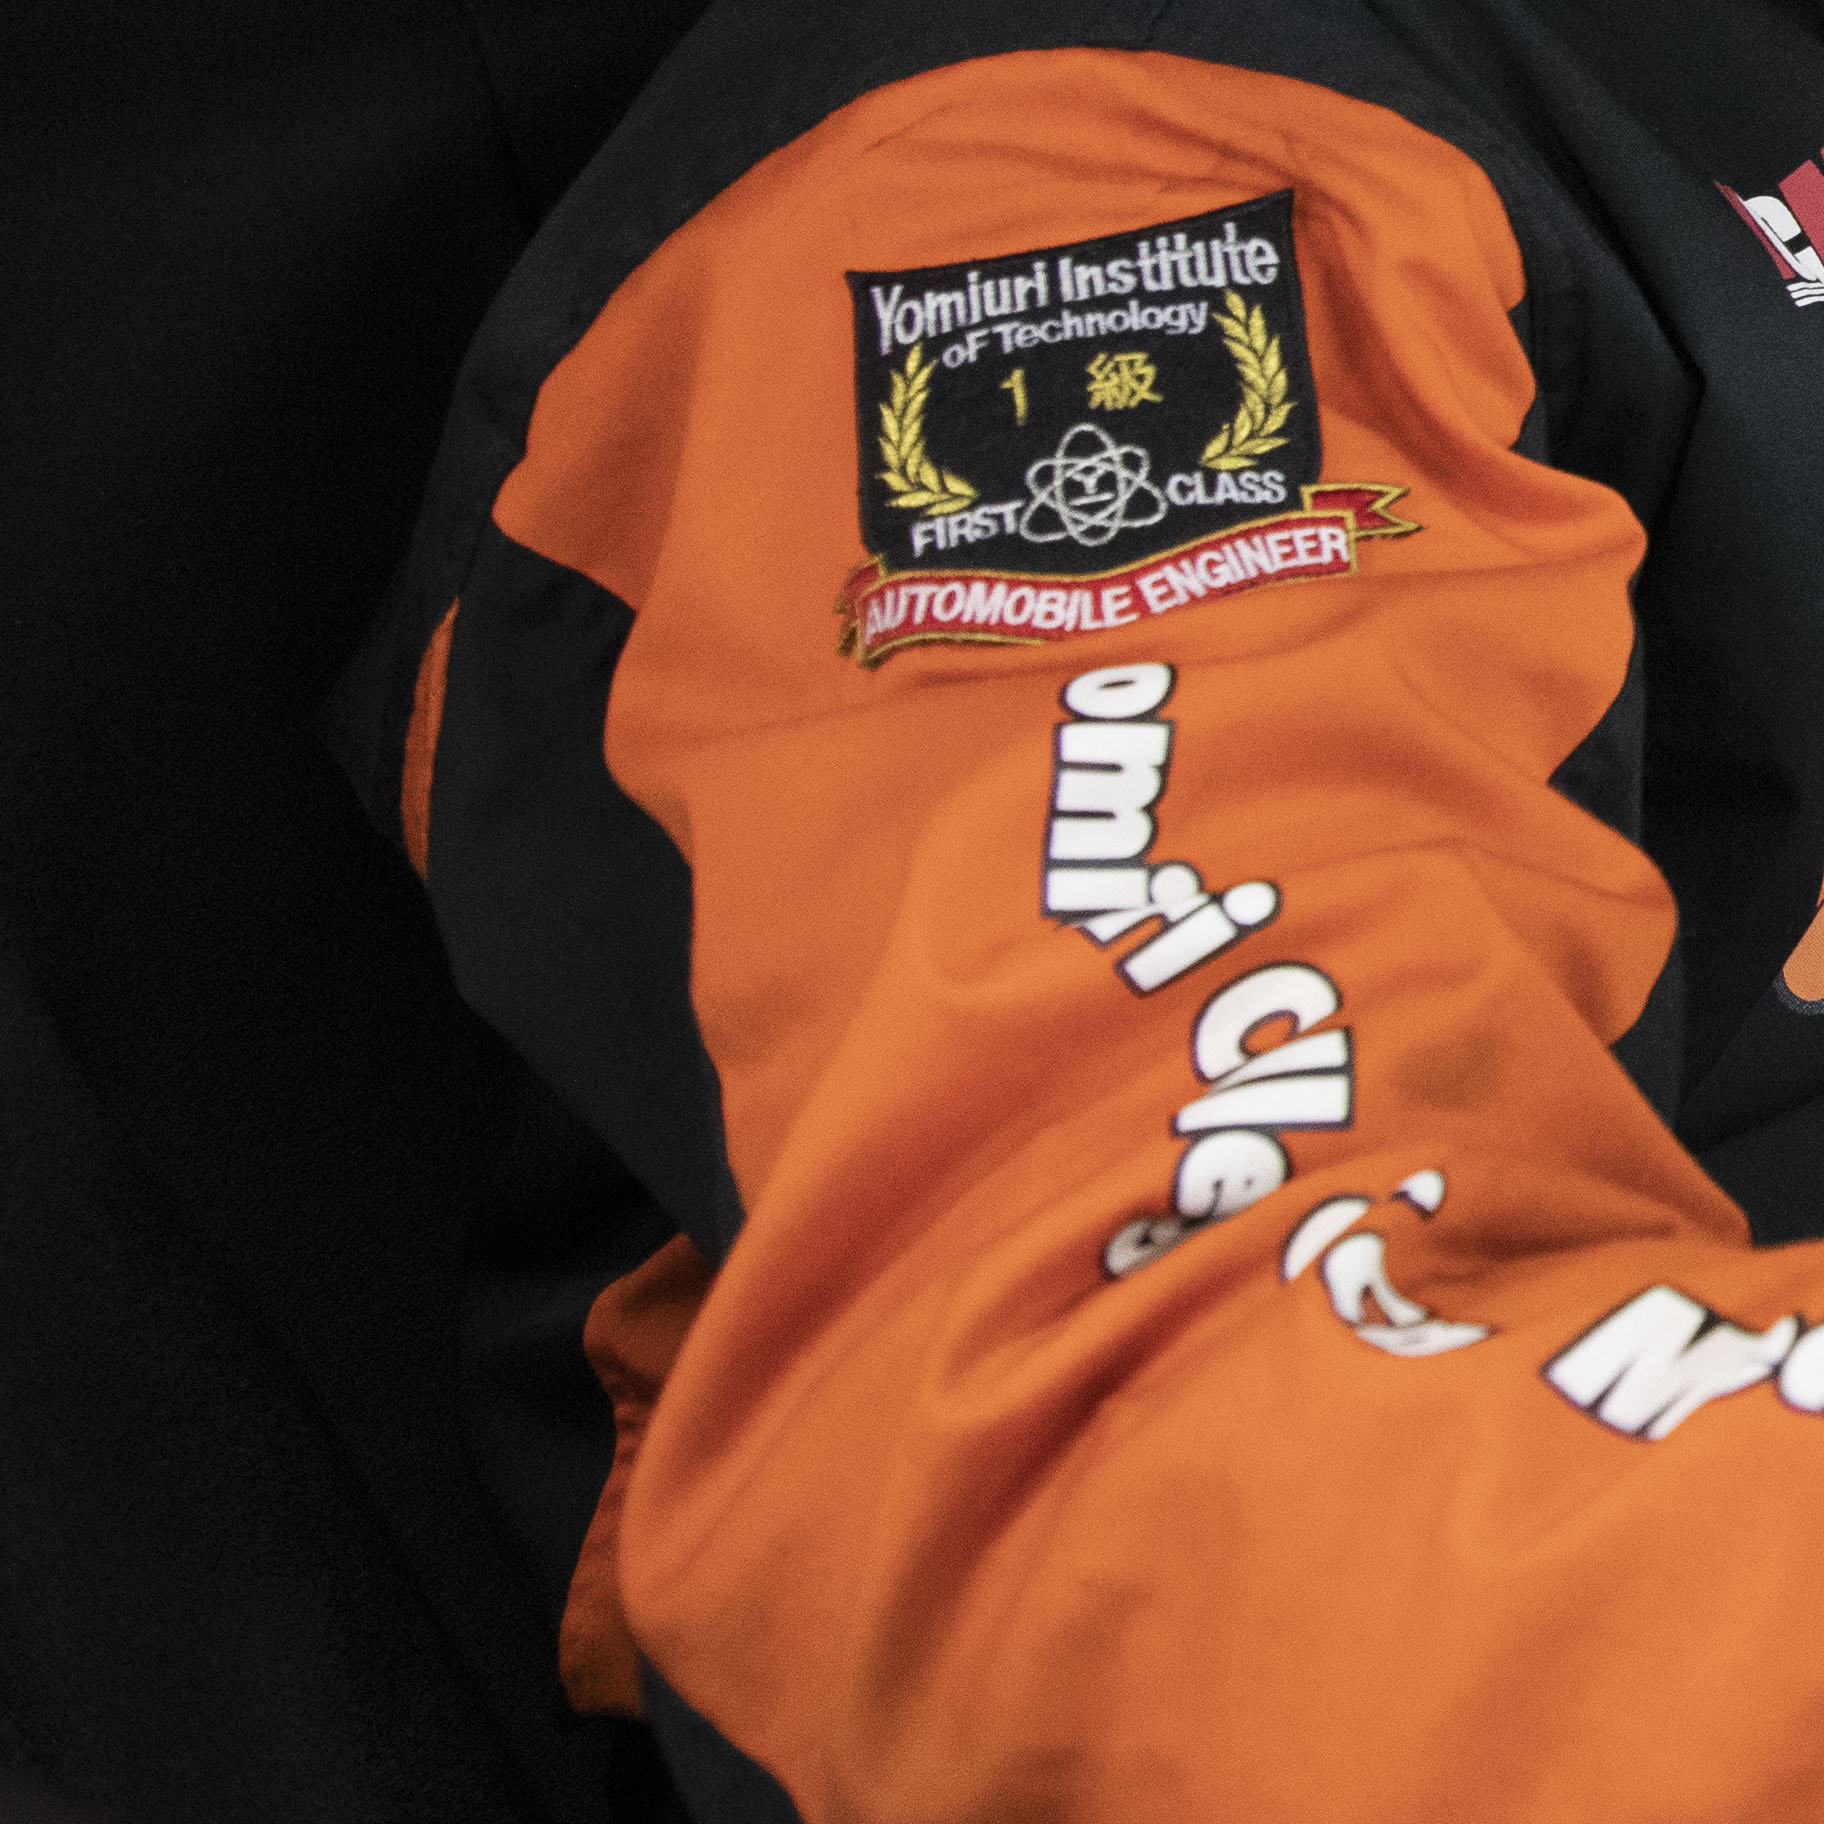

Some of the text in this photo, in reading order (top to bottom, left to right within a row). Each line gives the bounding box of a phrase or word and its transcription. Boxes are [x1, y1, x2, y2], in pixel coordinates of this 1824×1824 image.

[870, 222, 1281, 356] Yomiuri Institute
[998, 299, 1210, 356] Technology
[911, 470, 1287, 557] FIRST CLASS
[863, 526, 1351, 645] AUTOMOBILE ENGINEER
